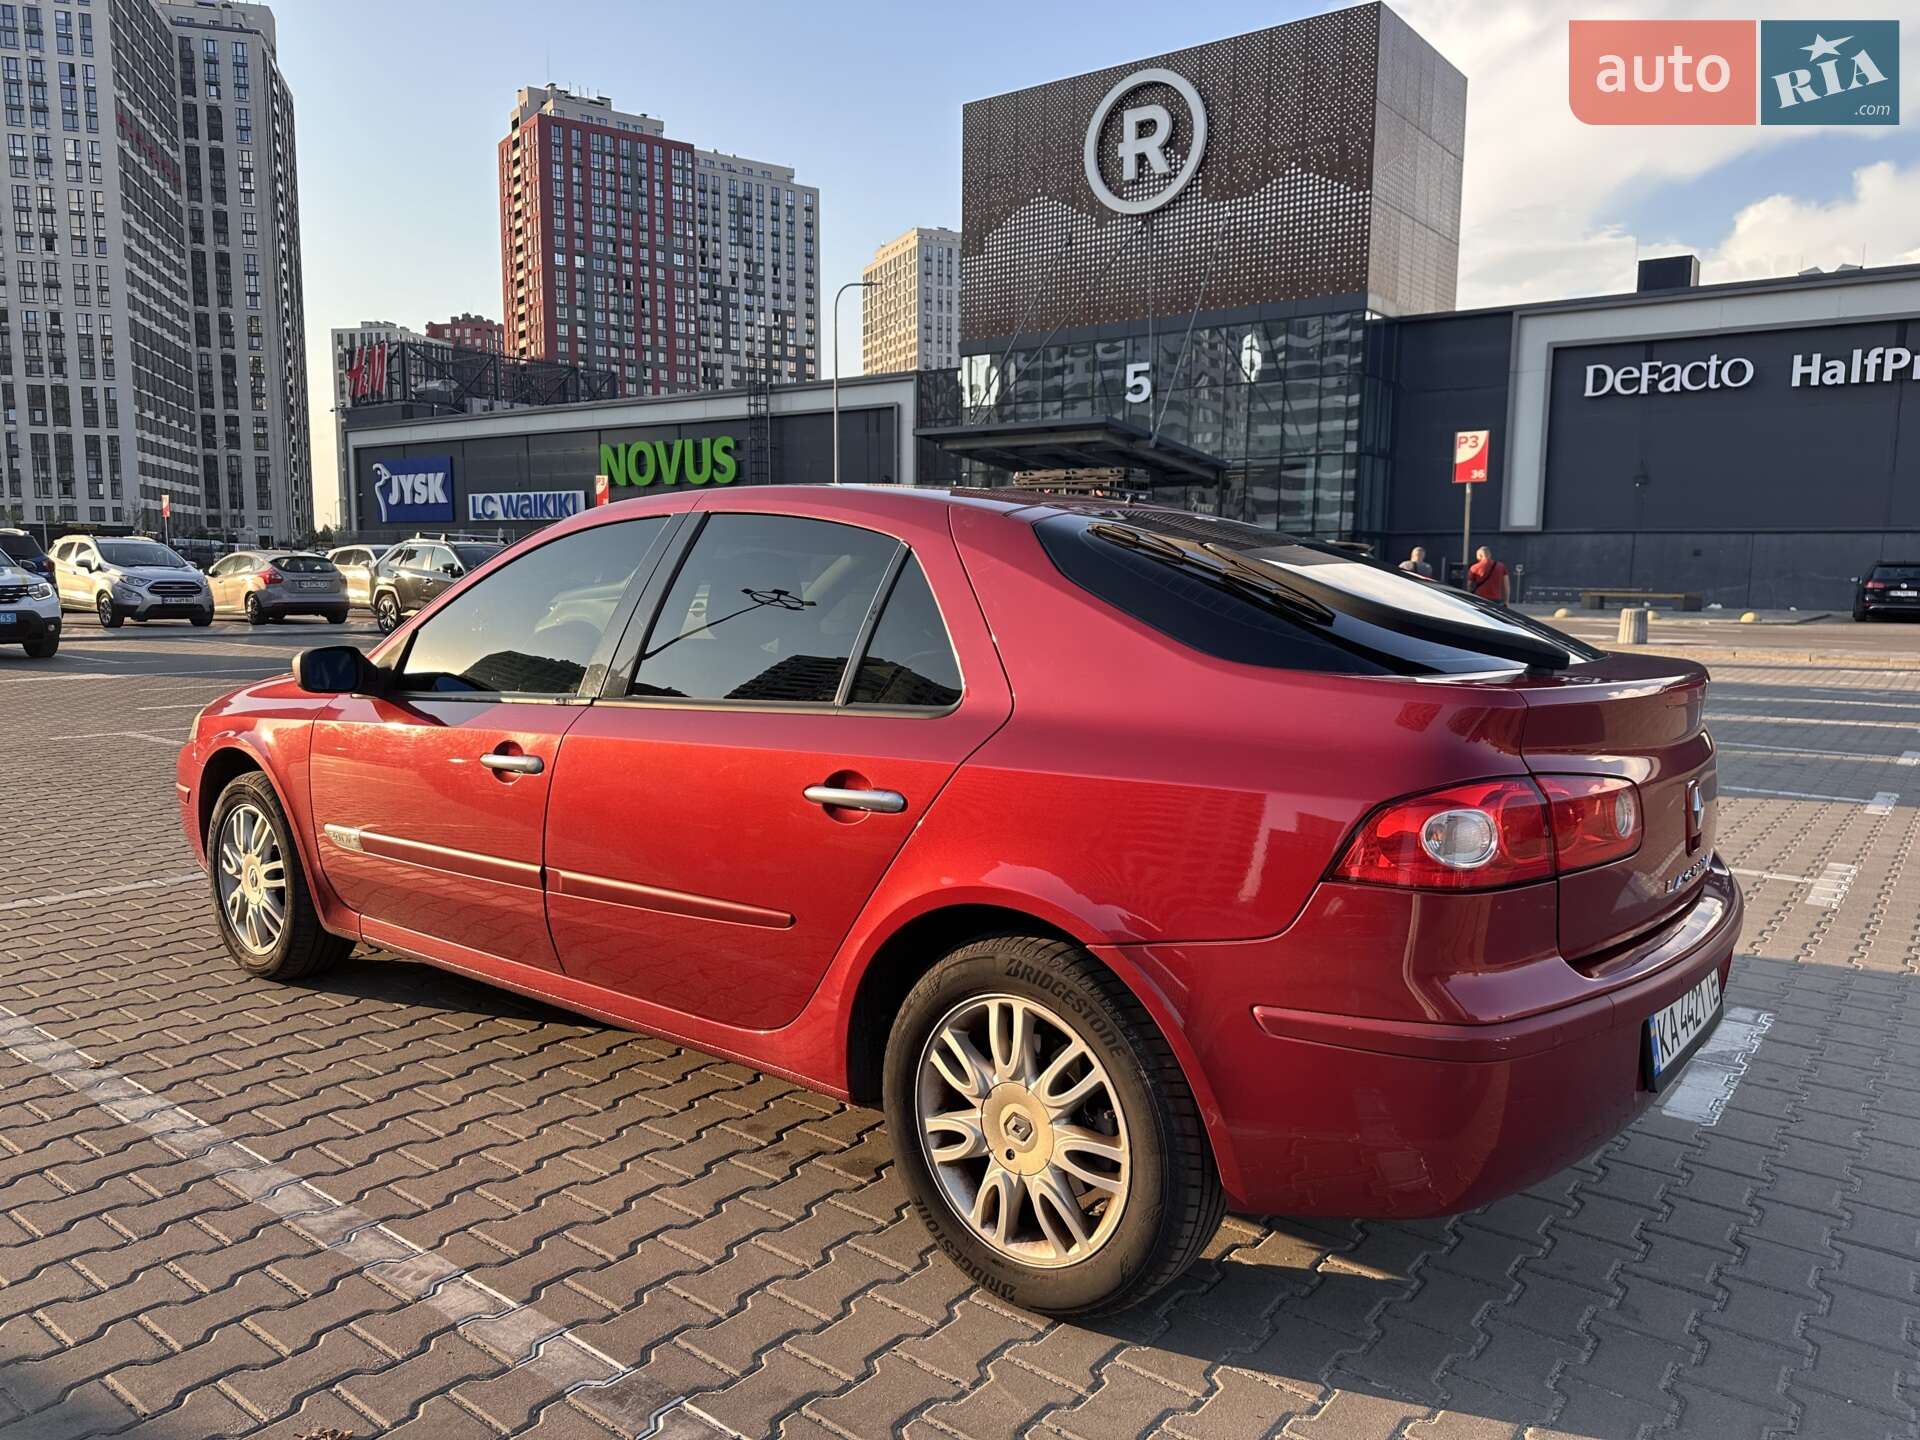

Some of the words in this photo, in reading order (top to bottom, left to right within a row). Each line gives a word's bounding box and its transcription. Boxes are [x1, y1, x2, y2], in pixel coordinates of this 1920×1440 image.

[1125, 362, 1152, 404] 5
[1584, 354, 1754, 397] DeFacto
[600, 435, 737, 487] NOVUS
[1457, 435, 1479, 449] P3
[388, 472, 448, 505] JYSK
[471, 494, 496, 520] LC
[1006, 959, 1128, 1058] BRIDGESTONE
[1657, 1006, 1681, 1064] KA
[911, 1194, 1017, 1302] BRIDGESTONE
